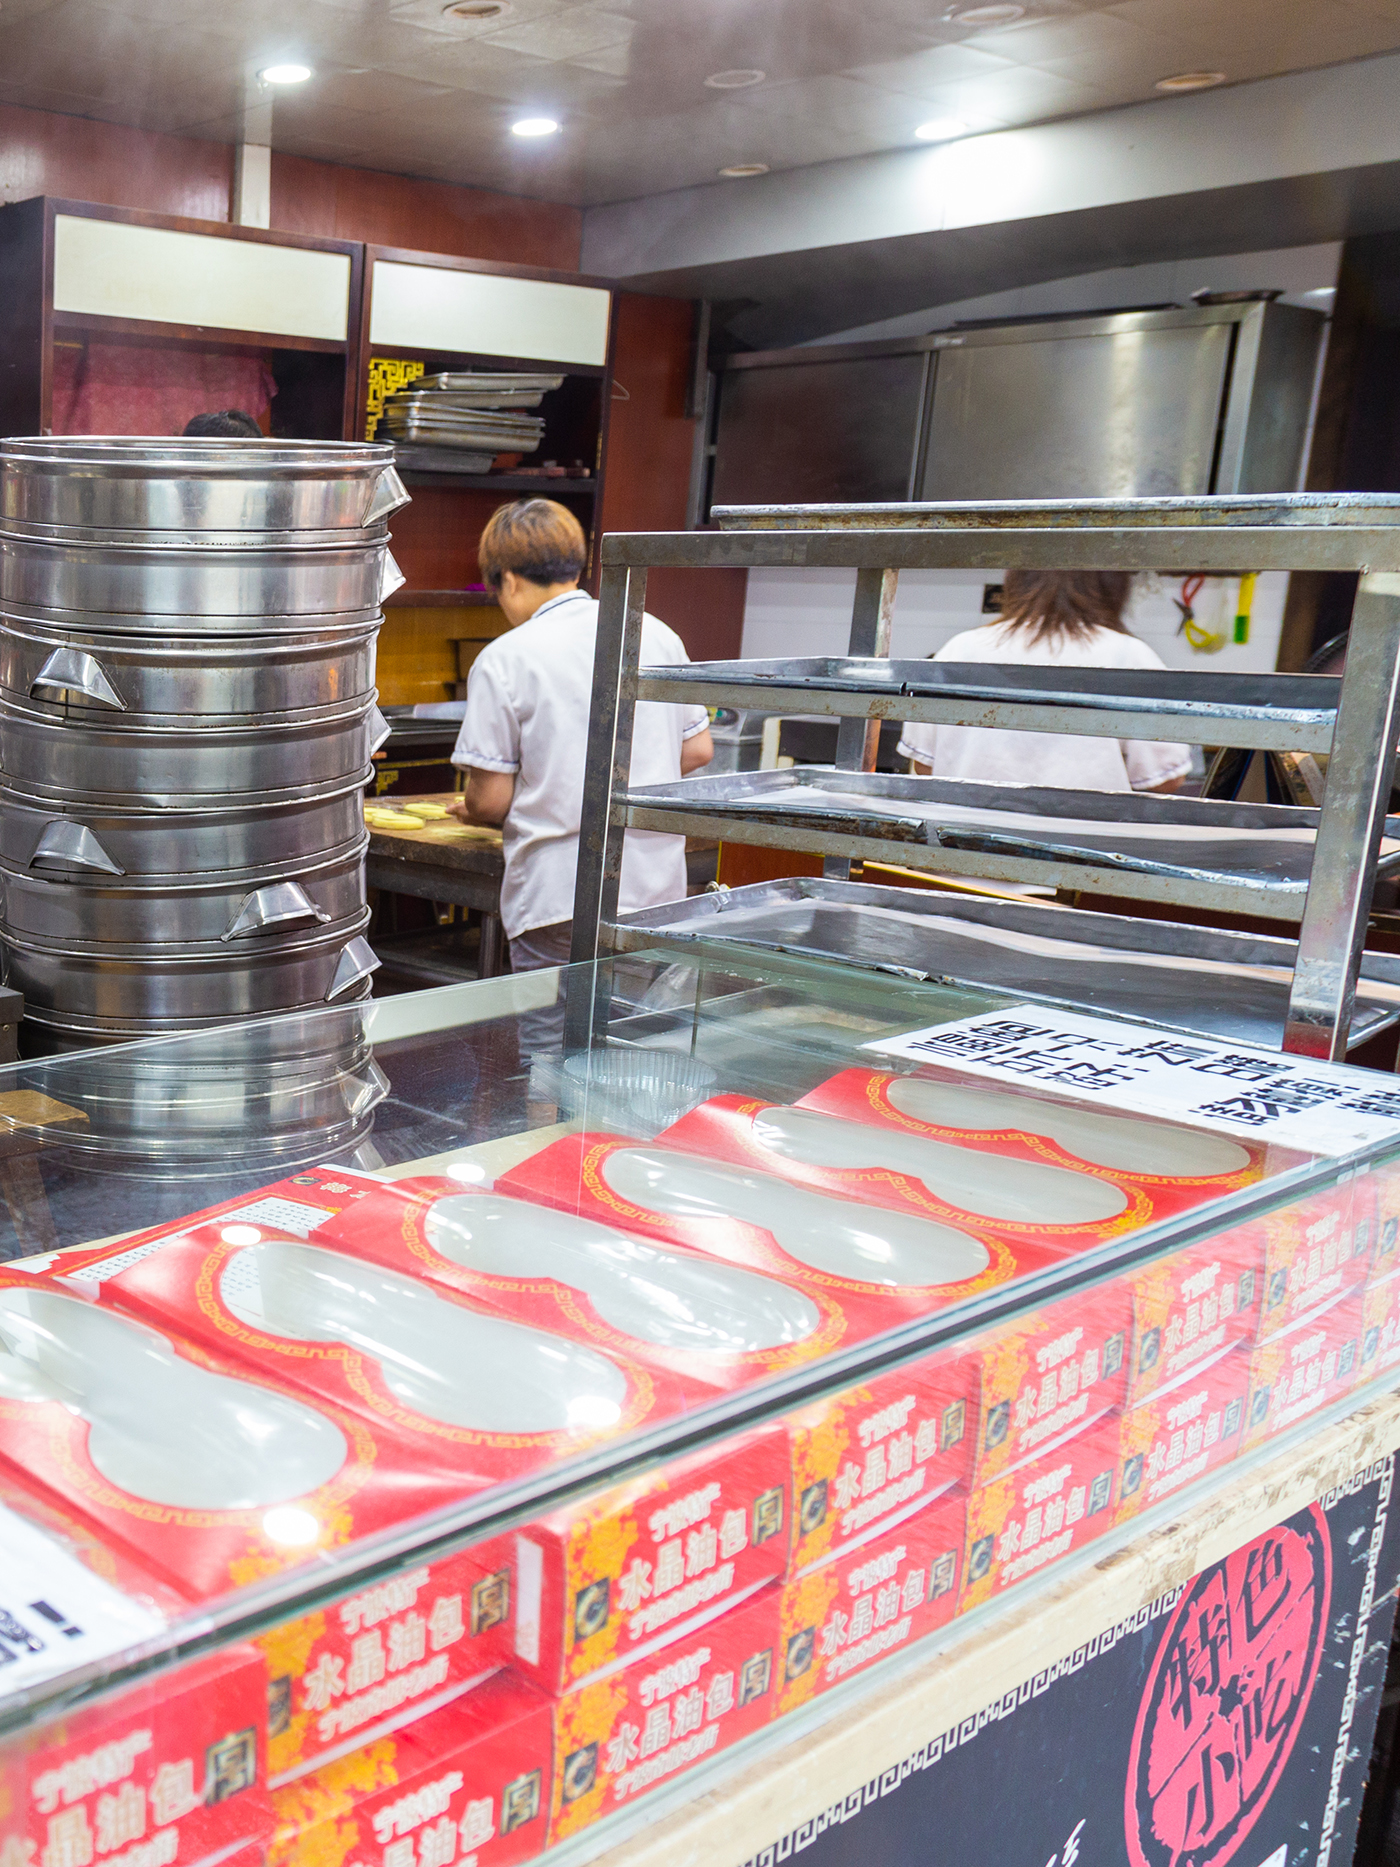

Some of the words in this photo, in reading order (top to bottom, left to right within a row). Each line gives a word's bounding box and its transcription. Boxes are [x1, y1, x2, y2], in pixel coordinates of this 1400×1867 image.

[1162, 1282, 1235, 1353] 水晶油包
[1014, 1348, 1099, 1428] 水晶油包
[833, 1417, 937, 1508] 水晶油包
[1145, 1409, 1221, 1480] 水晶油包
[618, 1508, 748, 1611] 水晶油包
[997, 1486, 1086, 1561] 水晶油包
[303, 1594, 466, 1711] 水晶油包
[820, 1569, 926, 1656] 水晶油包
[605, 1672, 735, 1773] 水晶油包
